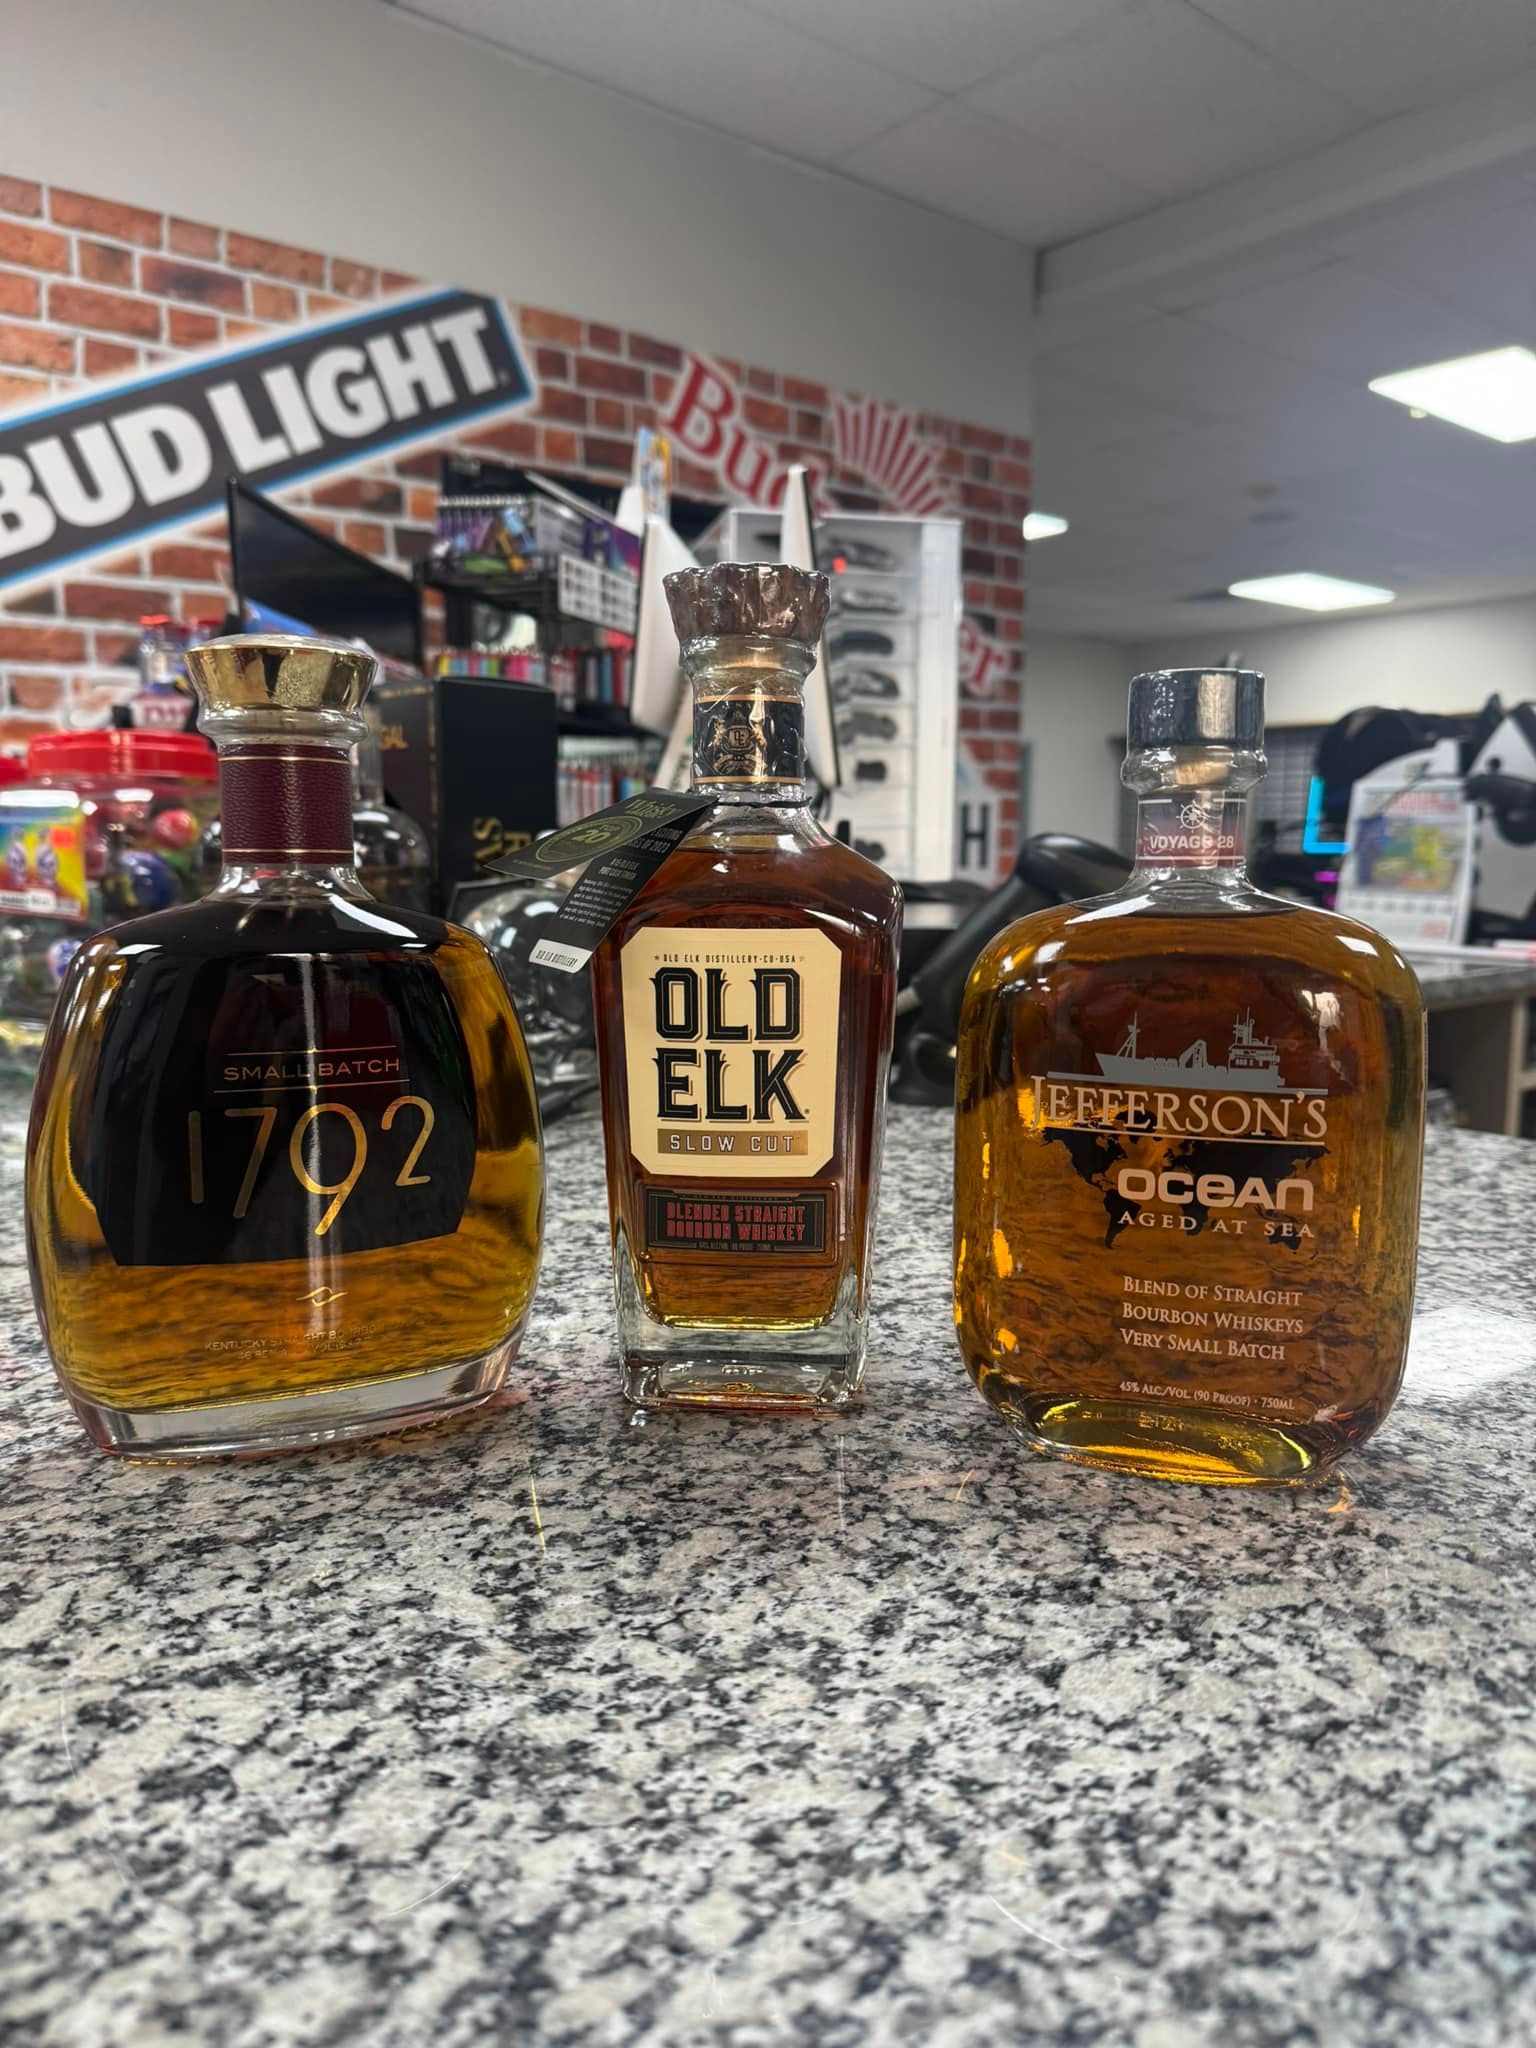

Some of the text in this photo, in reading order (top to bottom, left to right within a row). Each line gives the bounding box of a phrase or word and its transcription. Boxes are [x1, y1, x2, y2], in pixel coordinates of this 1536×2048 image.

[0, 307, 498, 557] BUD LIGHT
[1217, 835, 1234, 849] 28
[684, 953, 701, 963] ELK
[650, 967, 804, 1042] OLD
[223, 1058, 400, 1081] SMALL BATCH
[652, 1047, 807, 1122] ELK
[1029, 1075, 1328, 1139] JEFFERSON'S
[670, 1134, 794, 1152] SLOW CUT
[188, 1095, 435, 1236] 1792
[666, 1202, 806, 1223] BLENDED STRAIGHT
[1117, 1210, 1315, 1239] AGED AT SEA
[666, 1220, 806, 1241] BOURBON WHISKEY
[1122, 1275, 1303, 1307] BLEND OF STRAIGHT
[1121, 1302, 1304, 1334] BOURBON WHISKEYS
[1119, 1327, 1286, 1361] VERY SMALL BATCH
